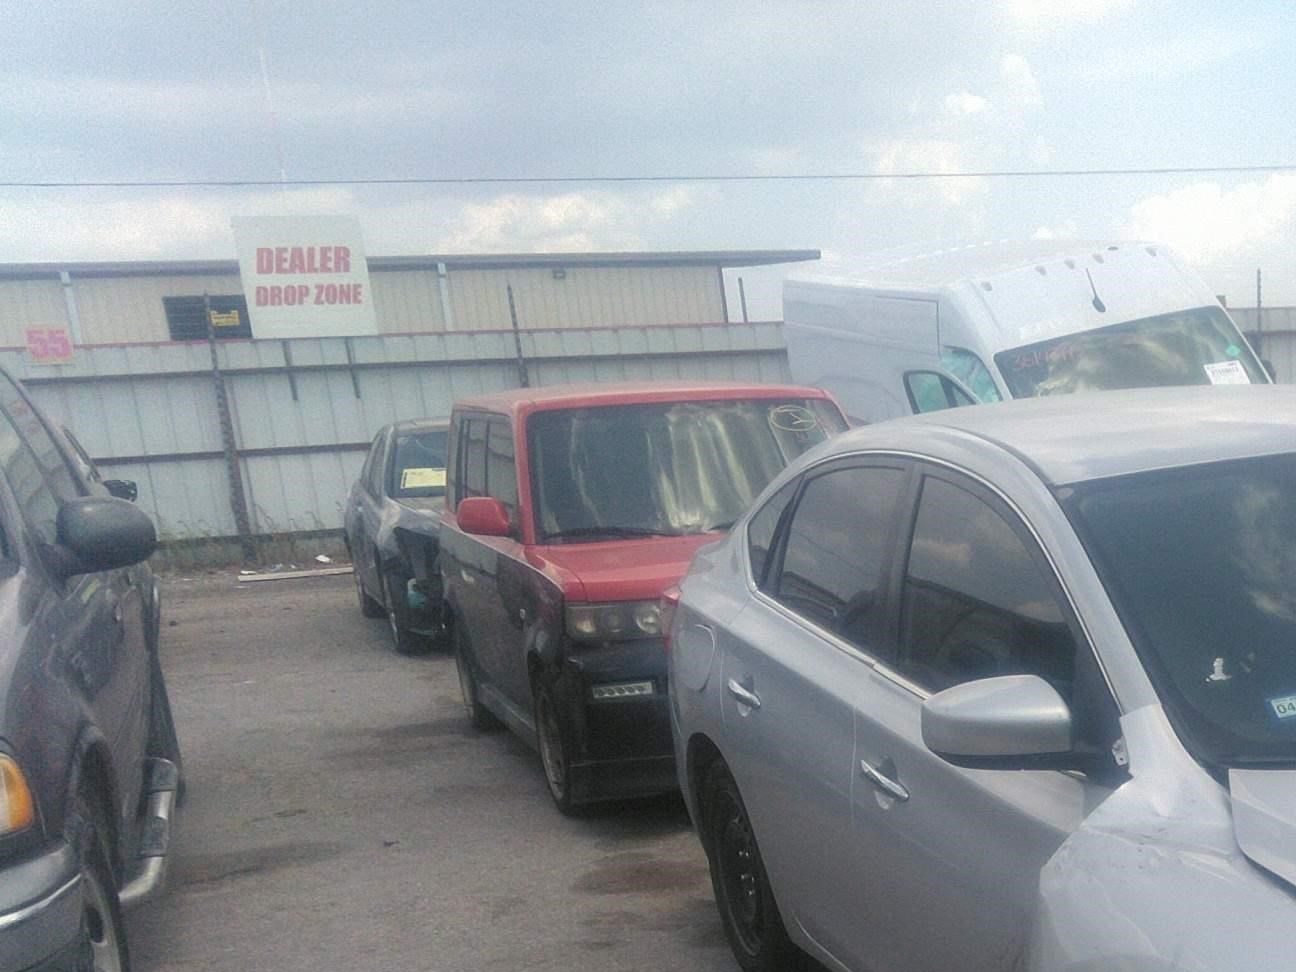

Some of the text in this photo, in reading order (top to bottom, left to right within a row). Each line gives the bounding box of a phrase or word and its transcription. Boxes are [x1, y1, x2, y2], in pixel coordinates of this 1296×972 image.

[256, 246, 351, 275] DEALER
[256, 283, 363, 307] DROP ZONE
[26, 329, 71, 359] 55
